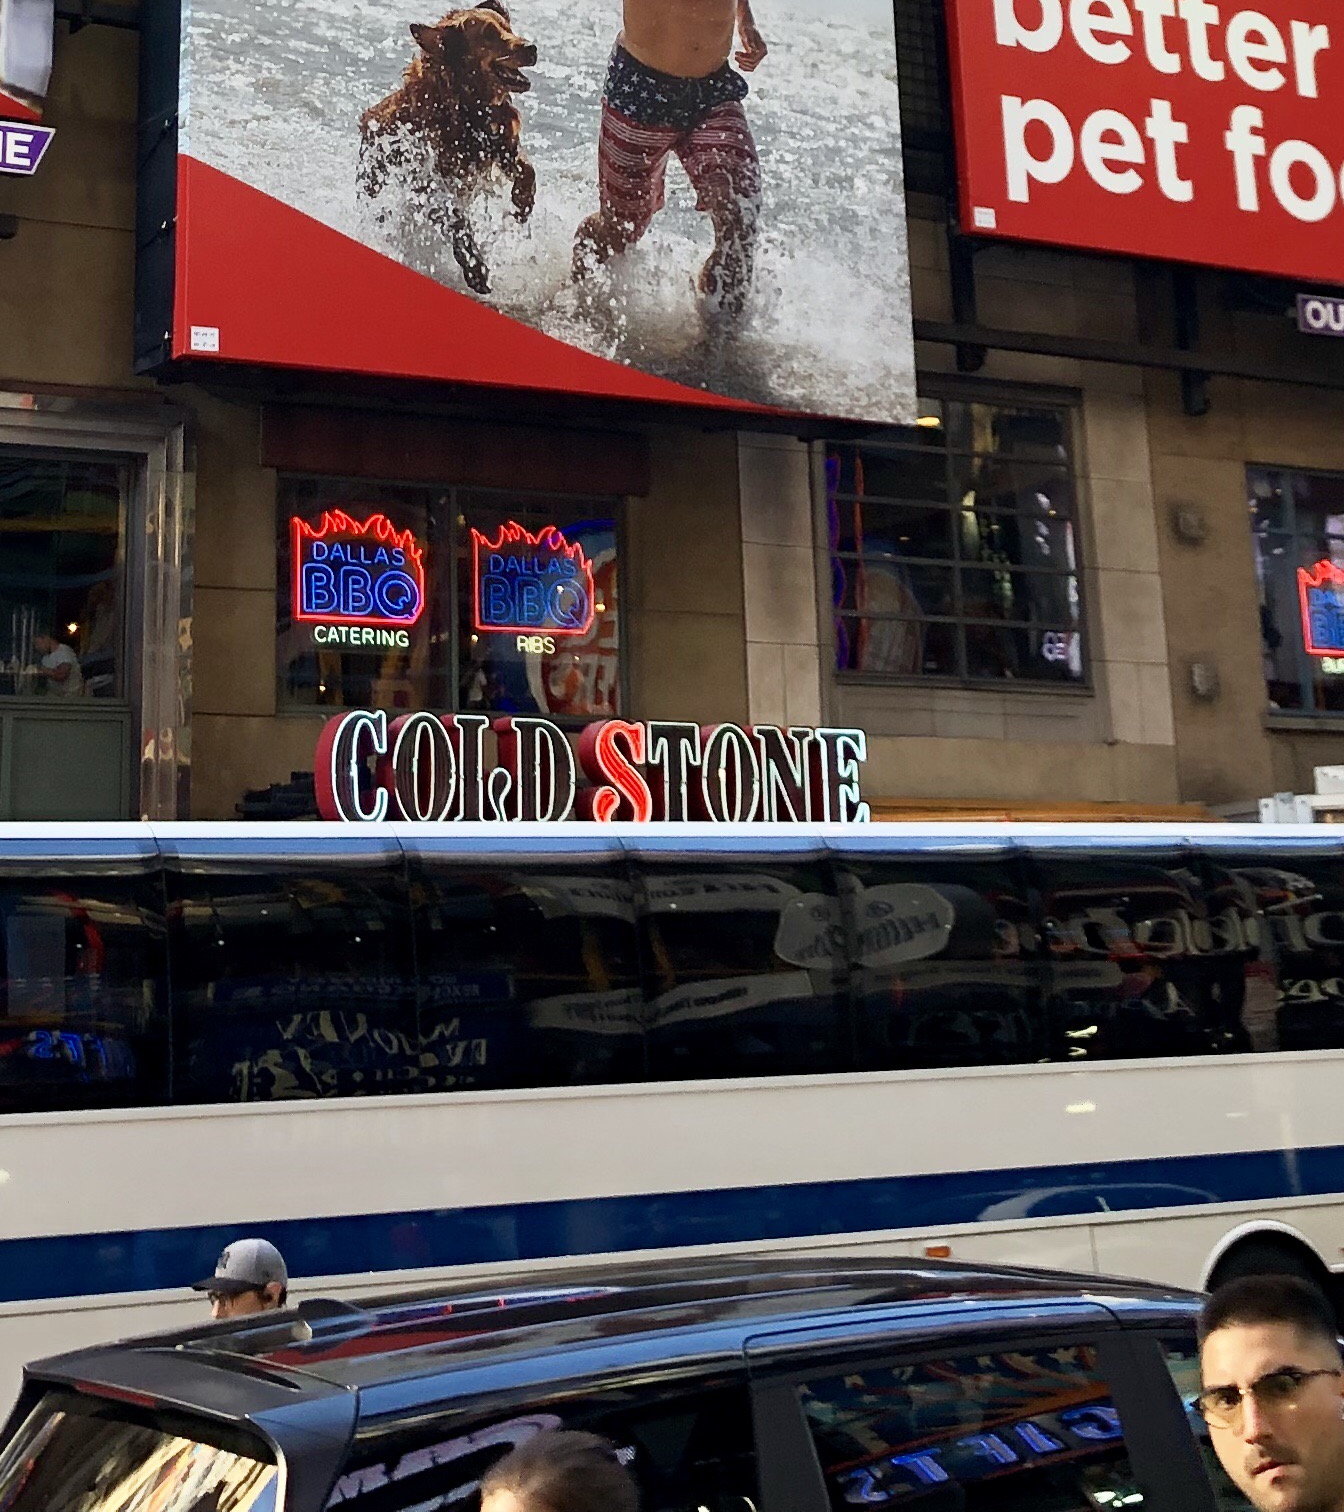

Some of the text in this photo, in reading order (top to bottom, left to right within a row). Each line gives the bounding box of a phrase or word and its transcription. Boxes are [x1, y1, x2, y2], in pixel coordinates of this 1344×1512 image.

[1001, 94, 1193, 204] pet
[312, 541, 406, 567] DALLAS
[488, 554, 578, 577] DALLAS
[302, 563, 421, 619] BBQ
[481, 573, 588, 628] BBQ
[314, 624, 410, 648] CATERING
[515, 634, 556, 655] RIBS
[330, 709, 871, 824] COLD STONE
